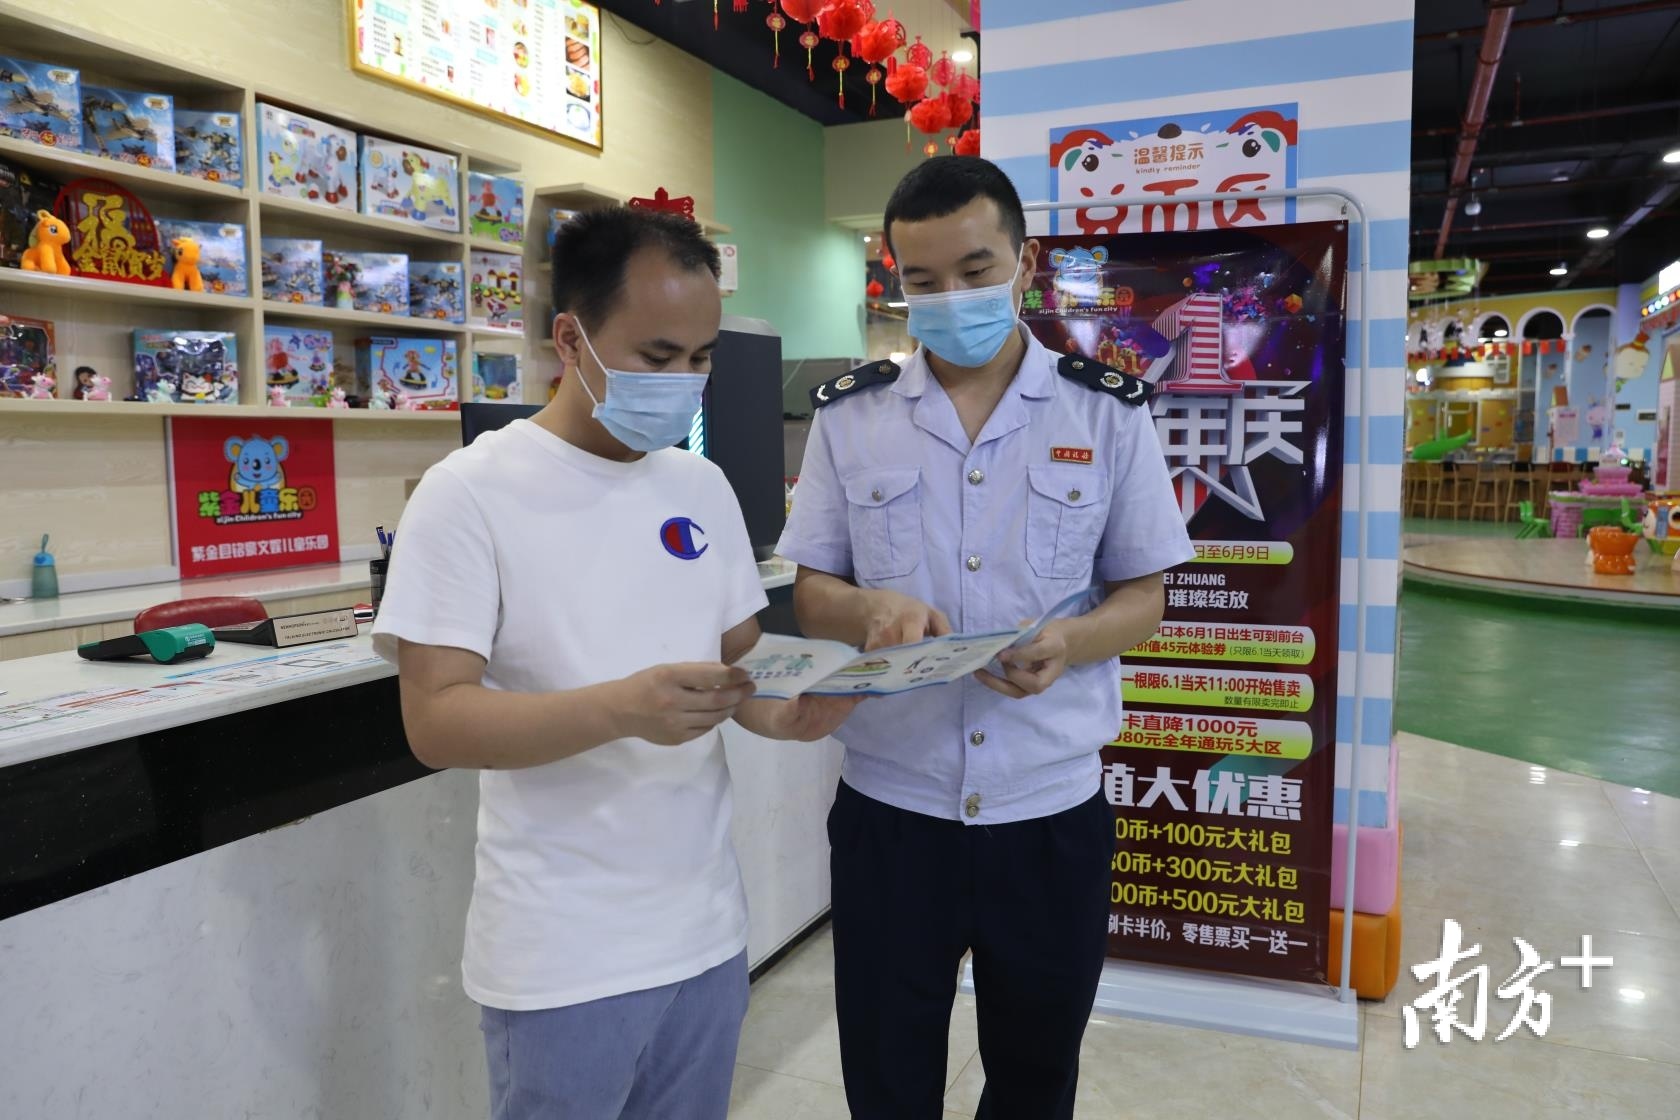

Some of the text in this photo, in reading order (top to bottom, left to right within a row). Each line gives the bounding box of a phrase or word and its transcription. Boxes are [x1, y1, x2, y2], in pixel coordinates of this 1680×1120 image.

[1134, 142, 1204, 165] 温馨提示
[1136, 164, 1201, 174] kindly reminder
[73, 244, 166, 280] 金鼠贺岁
[1193, 545, 1270, 560] 日至6月9日
[1176, 573, 1226, 586] ZHUANG
[1168, 589, 1249, 609] 璀璨绽放
[1224, 696, 1299, 710] 数量有限卖完即止
[1123, 713, 1258, 737] 卡直降1000元
[1116, 817, 1291, 855] 0币+100元大礼包
[1111, 881, 1305, 923] 00币+500元大礼包
